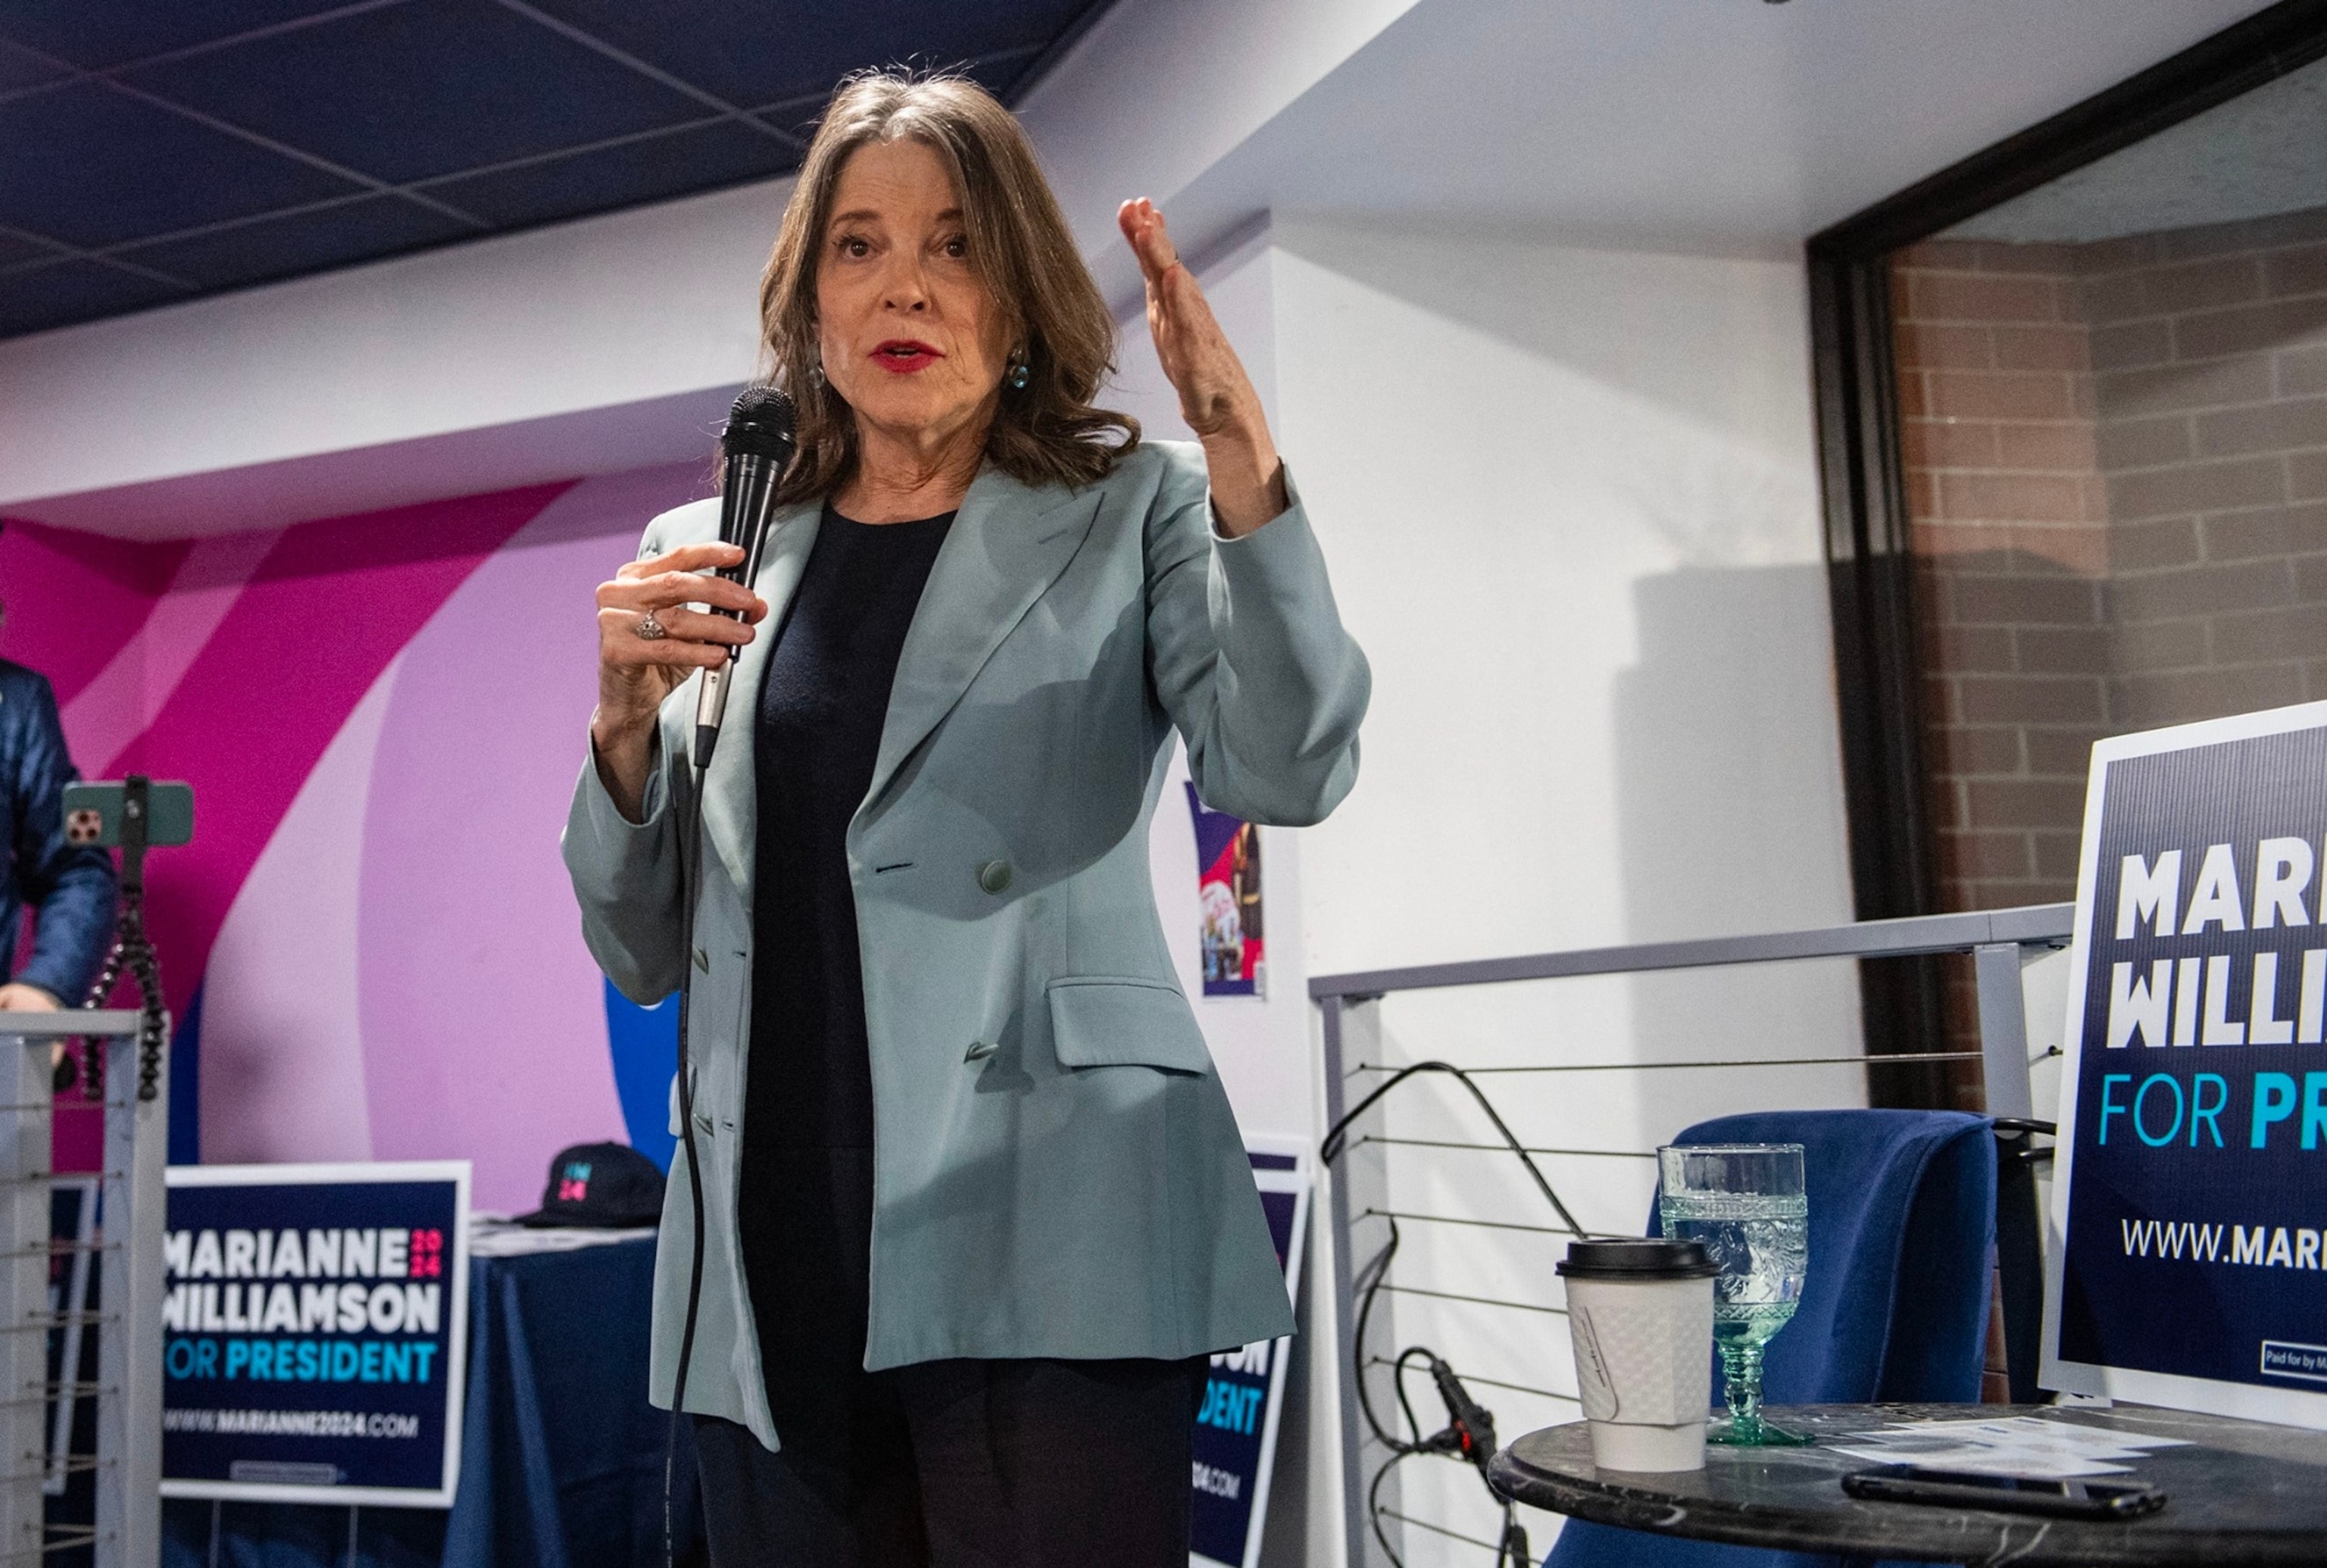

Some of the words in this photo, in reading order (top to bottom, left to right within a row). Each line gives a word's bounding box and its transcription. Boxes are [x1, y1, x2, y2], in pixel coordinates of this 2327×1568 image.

[2107, 948, 2327, 1049] WILLI
[2099, 1073, 2229, 1148] FOR
[163, 1228, 410, 1279] MARIANNE
[161, 1282, 441, 1334] WILLIAMSON
[164, 1338, 219, 1381] OR
[225, 1338, 439, 1384] PRESIDENT
[2266, 1350, 2287, 1364] Paid
[2288, 1351, 2302, 1367] for
[2303, 1354, 2316, 1370] by
